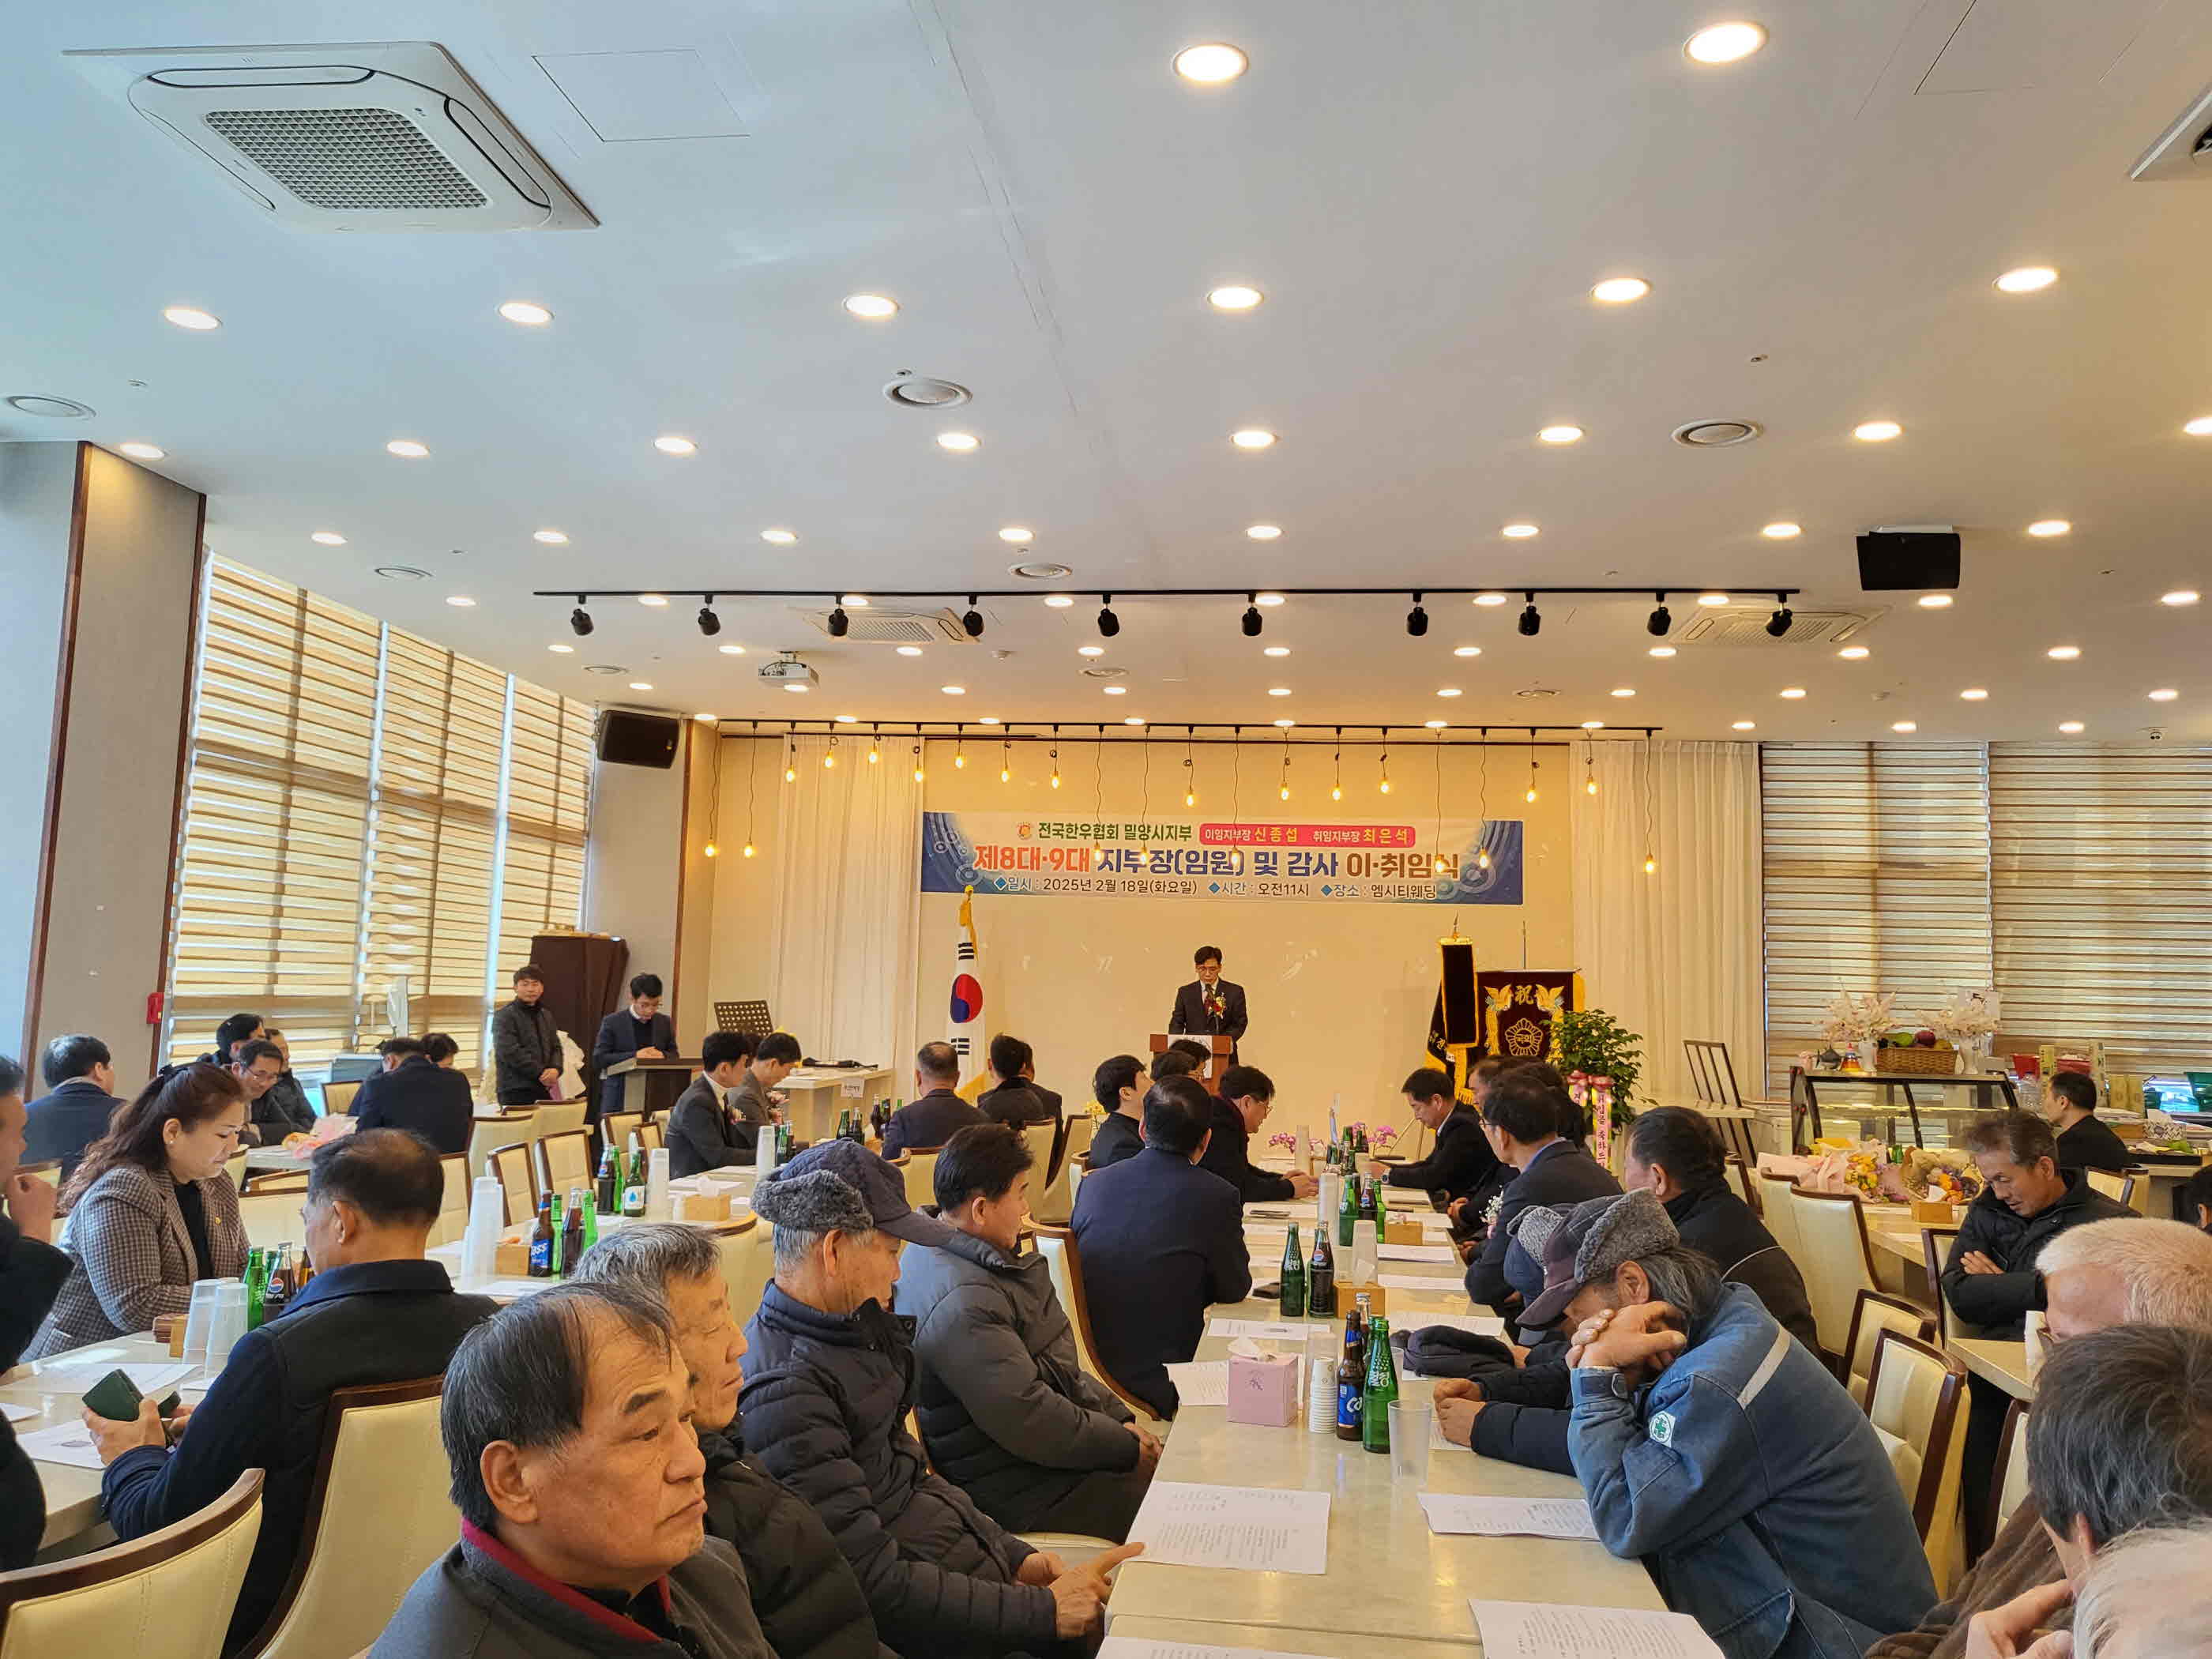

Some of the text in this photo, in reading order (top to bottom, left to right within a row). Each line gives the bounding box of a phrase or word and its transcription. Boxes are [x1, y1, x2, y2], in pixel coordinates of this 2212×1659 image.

[1039, 822, 1191, 841] 전국한우협회 밀양시지부
[1205, 829, 1251, 841] 이임지부장
[1313, 830, 1360, 842] 취임지부장
[1254, 852, 1278, 876] 및
[1288, 852, 1338, 877] 감사
[1044, 878, 1091, 892] 2025년
[1096, 879, 1116, 893] 2월
[1120, 880, 1197, 894] 18일(화요일)
[1258, 882, 1309, 896] 오전11시
[1371, 884, 1436, 899] 엠시티웨딩
